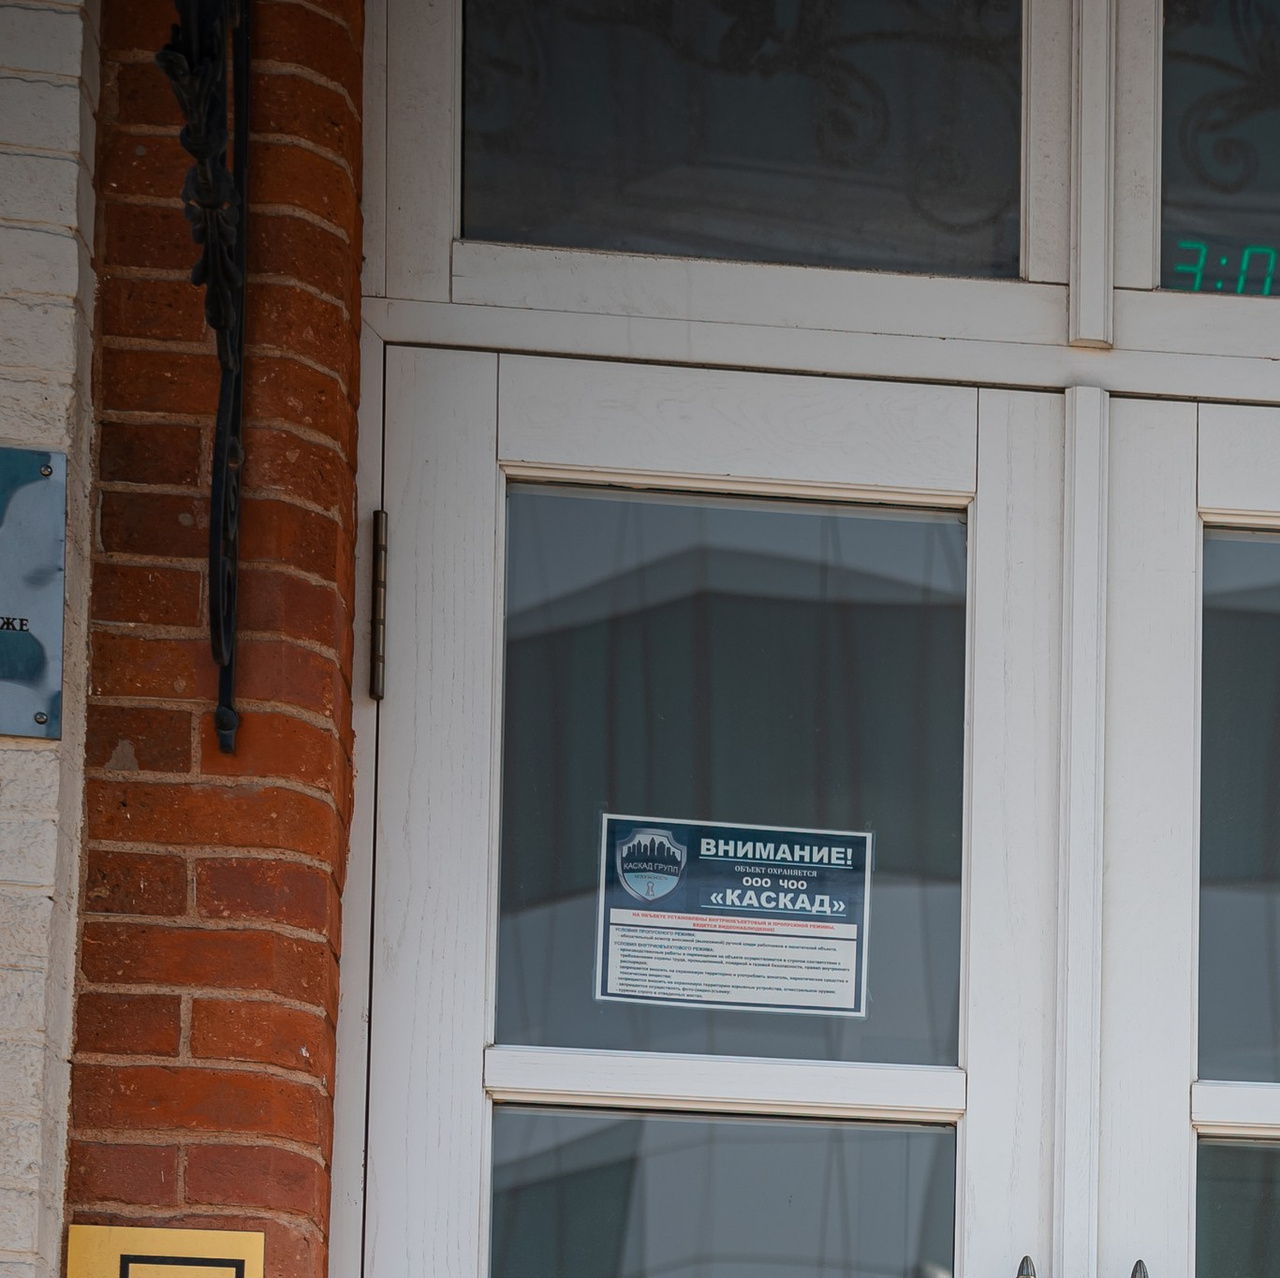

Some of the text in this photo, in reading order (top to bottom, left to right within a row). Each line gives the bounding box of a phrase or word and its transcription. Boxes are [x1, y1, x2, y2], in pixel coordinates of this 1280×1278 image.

[701, 838, 853, 865] ВНИМАНИЕ!
[623, 862, 678, 873] КАСКАД ГРУПП
[735, 865, 817, 877] ОБЪЕКТ ОХРАНЯЕТСЯ
[742, 876, 807, 890] ООО ЧОО
[710, 888, 846, 914] «КАСКАД»
